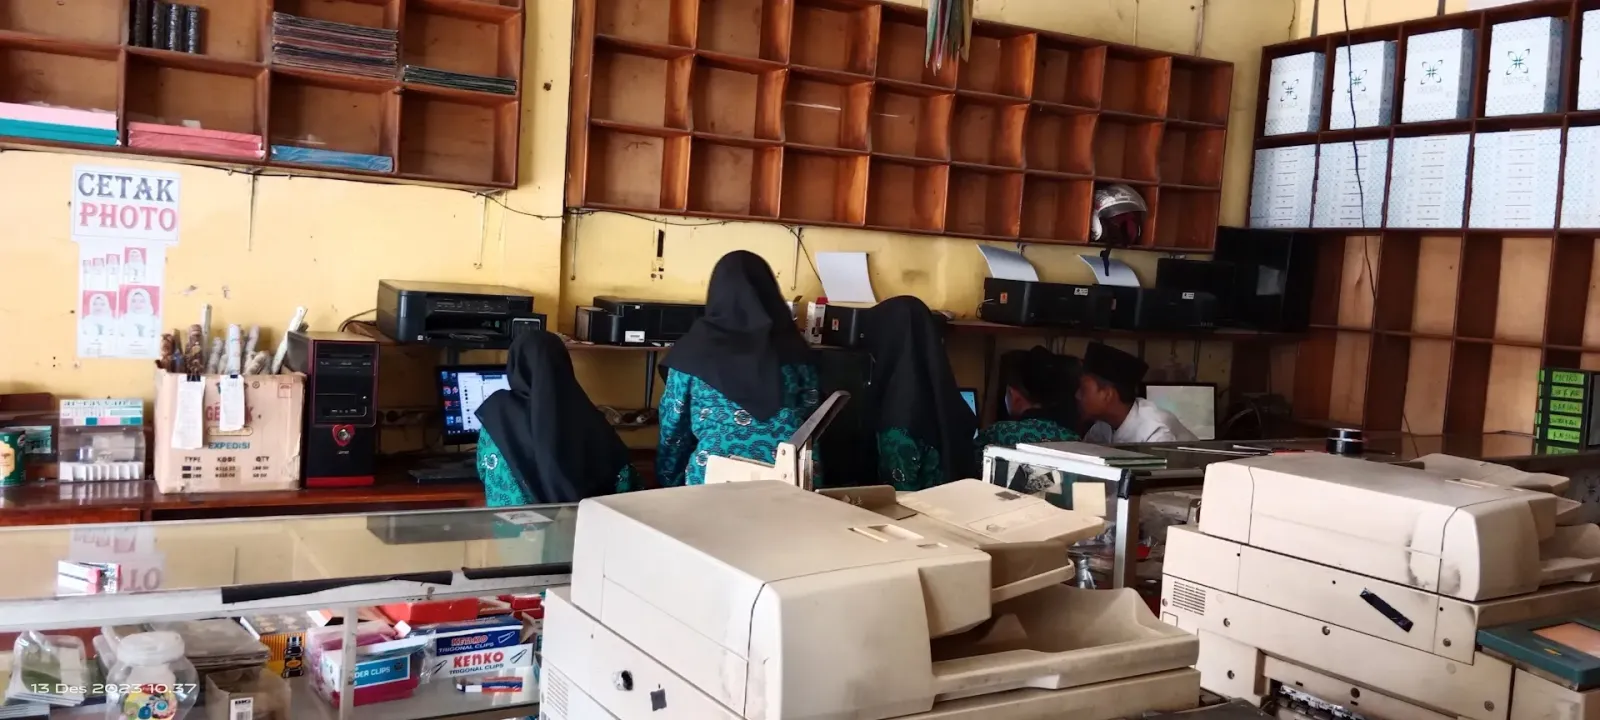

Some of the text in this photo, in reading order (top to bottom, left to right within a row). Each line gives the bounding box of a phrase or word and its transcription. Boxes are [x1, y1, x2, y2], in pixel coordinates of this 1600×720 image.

[78, 172, 175, 202] CETAK
[79, 202, 177, 232] PHOTO
[208, 441, 251, 450] EXPEDISI
[354, 666, 391, 678] DER CLIPS
[450, 667, 483, 675] TRIGONAL
